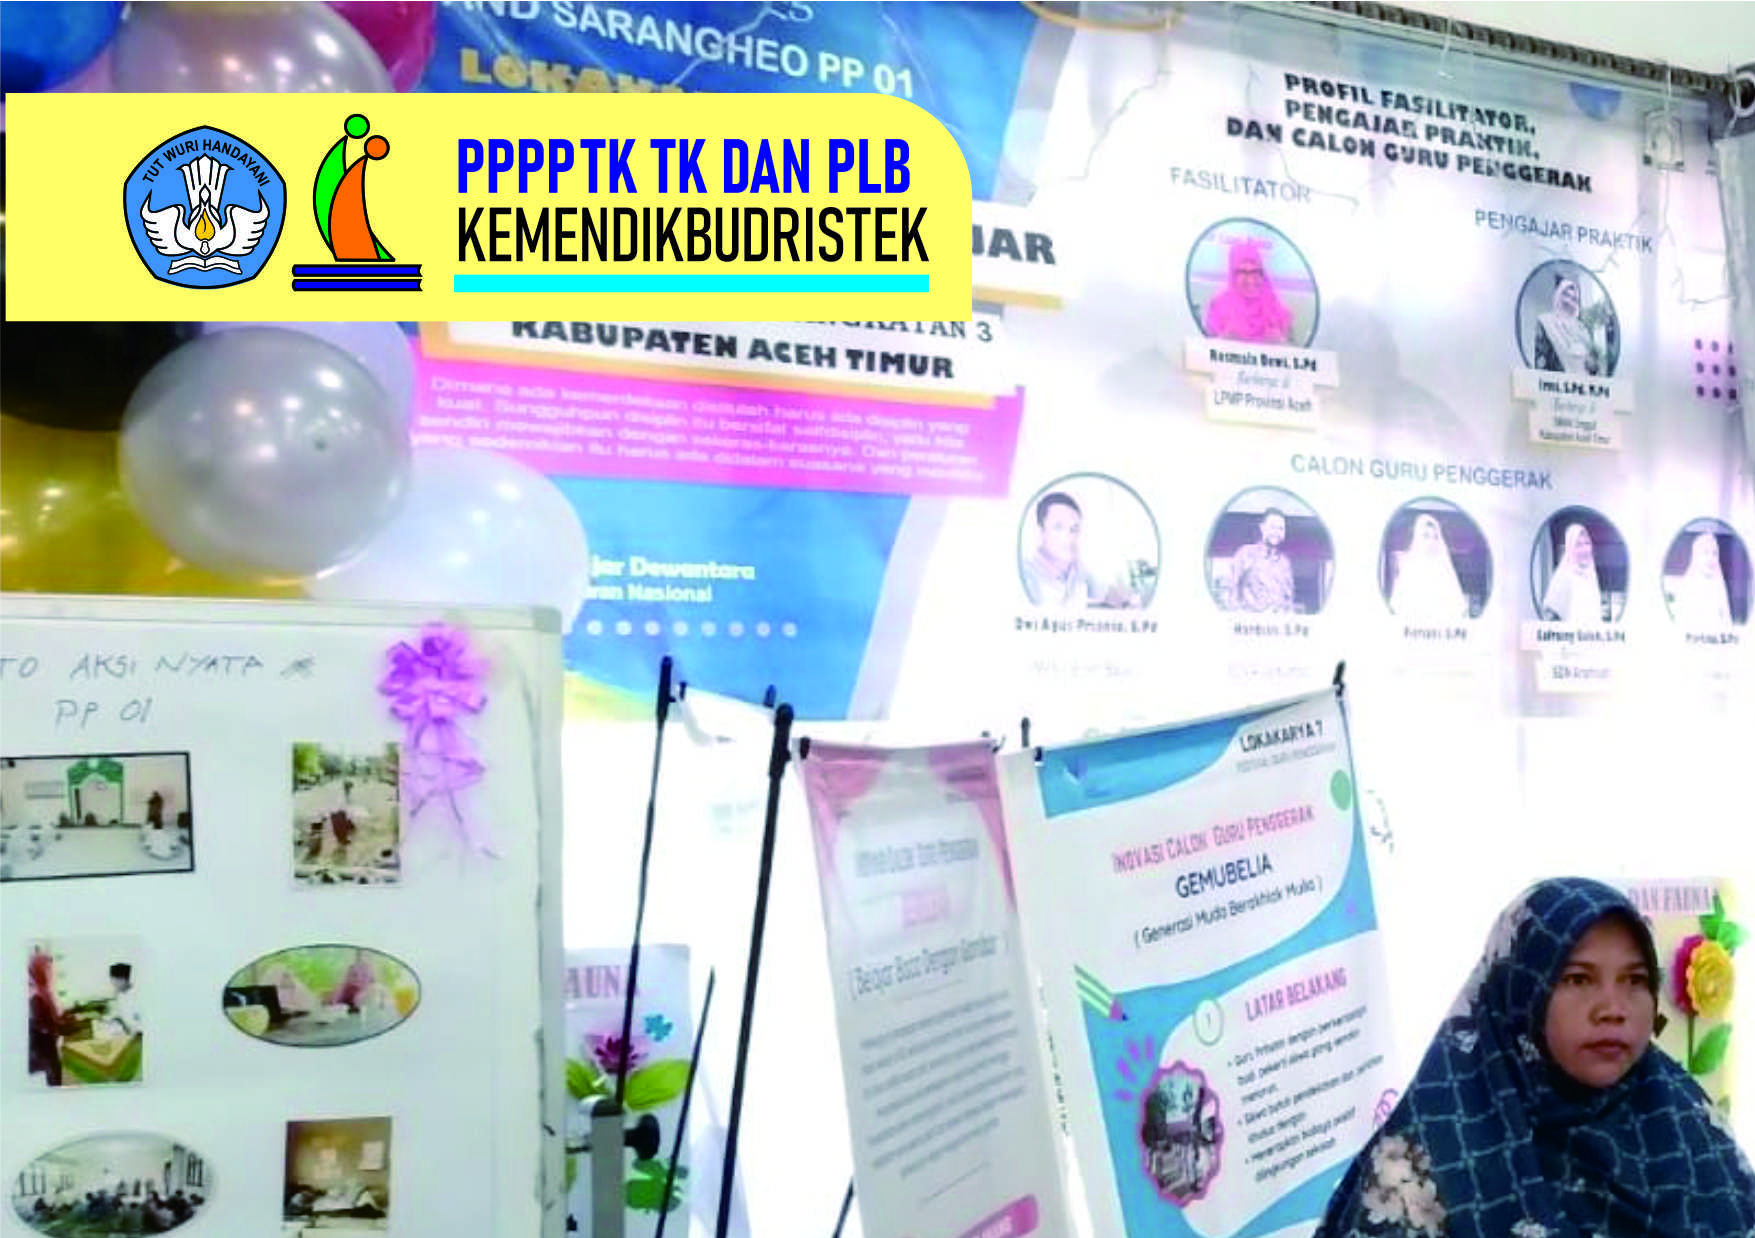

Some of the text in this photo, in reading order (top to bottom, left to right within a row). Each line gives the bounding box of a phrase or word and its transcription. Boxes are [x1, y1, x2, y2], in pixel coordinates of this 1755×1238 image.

[553, 0, 808, 78] SARANGHEO
[818, 52, 864, 88] PP
[873, 62, 914, 98] 01
[1284, 72, 1376, 108] PROFIL
[1285, 99, 1419, 140] PENGAJAR
[1226, 115, 1594, 195] DAN CALON GURU PENGGERAK
[1170, 166, 1312, 204] FASILITATOR
[1475, 208, 1653, 255] PENGAJAR PRAKTIK
[511, 321, 955, 379] KABUPATEN ACEH TIMUR
[976, 322, 993, 342] 3
[1290, 453, 1553, 491] CALON GURU PENGGERAK
[629, 556, 756, 581] Dewantara
[627, 582, 713, 603] Nasional
[69, 651, 138, 680] AKSI
[55, 696, 153, 729] PP 01
[1240, 722, 1315, 754] LOKAKARYA
[1113, 803, 1316, 875] INOVASI CALON GURU PENGGERAK
[1175, 851, 1273, 899] GEMUBELIA
[1244, 988, 1286, 1022] LATAR
[1286, 966, 1348, 1006] BELAKANG
